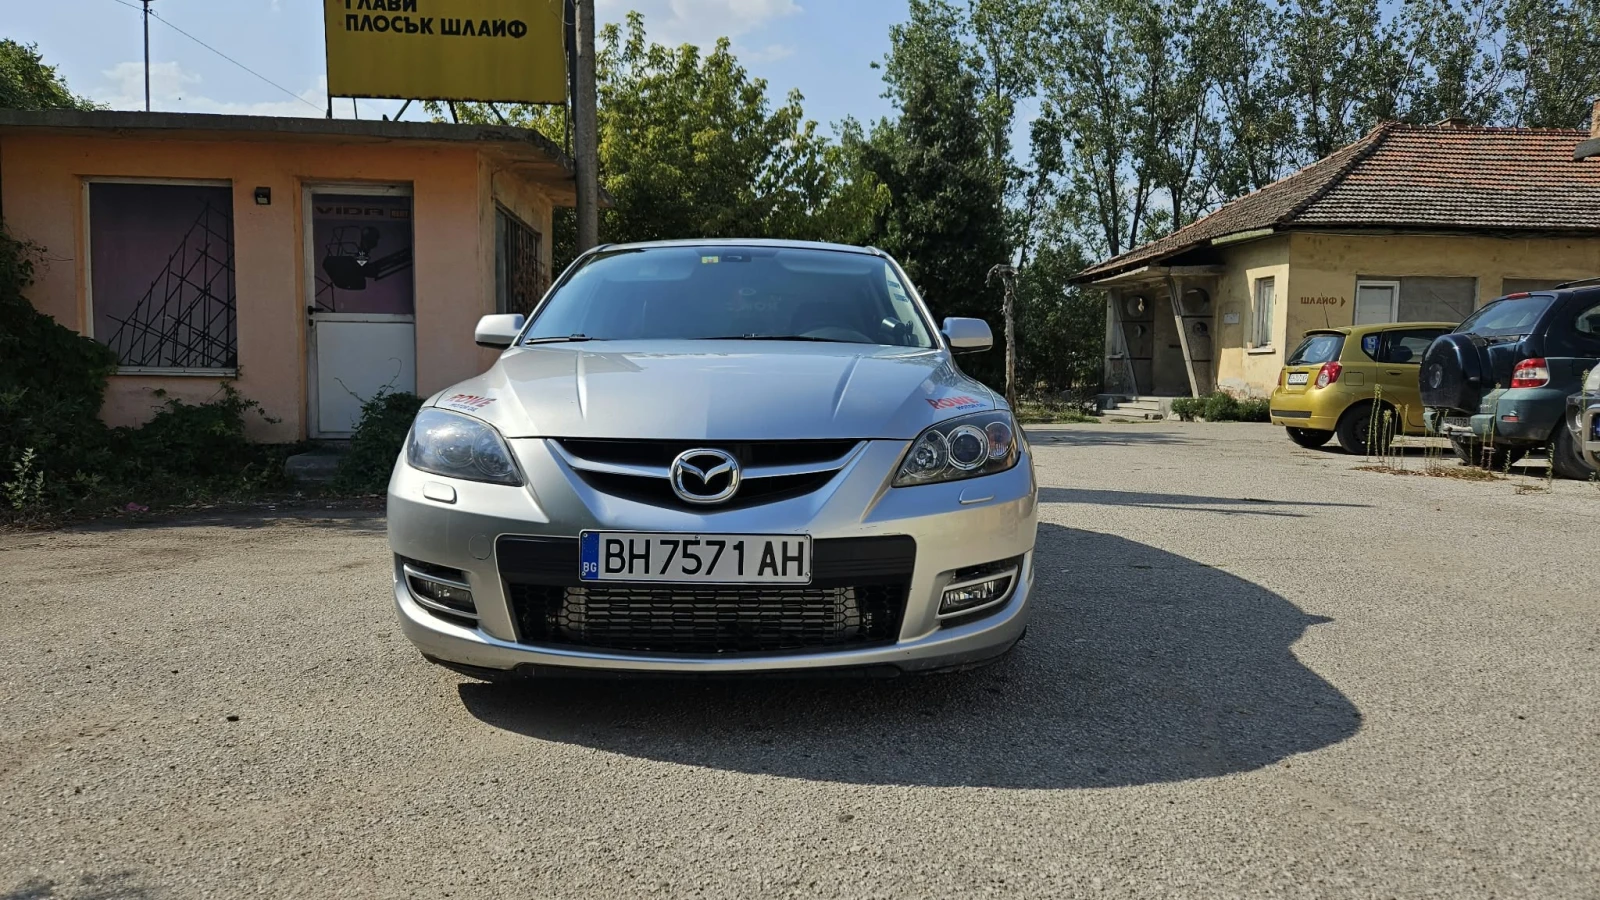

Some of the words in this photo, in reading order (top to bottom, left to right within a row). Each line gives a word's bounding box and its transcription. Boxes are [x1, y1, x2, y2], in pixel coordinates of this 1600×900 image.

[346, 14, 434, 34] ПЛОСЪК
[441, 18, 527, 38] ШЛАЙФ
[583, 562, 597, 572] BG
[605, 539, 650, 574] BH
[659, 540, 744, 576] 7571
[757, 541, 804, 577] AH
